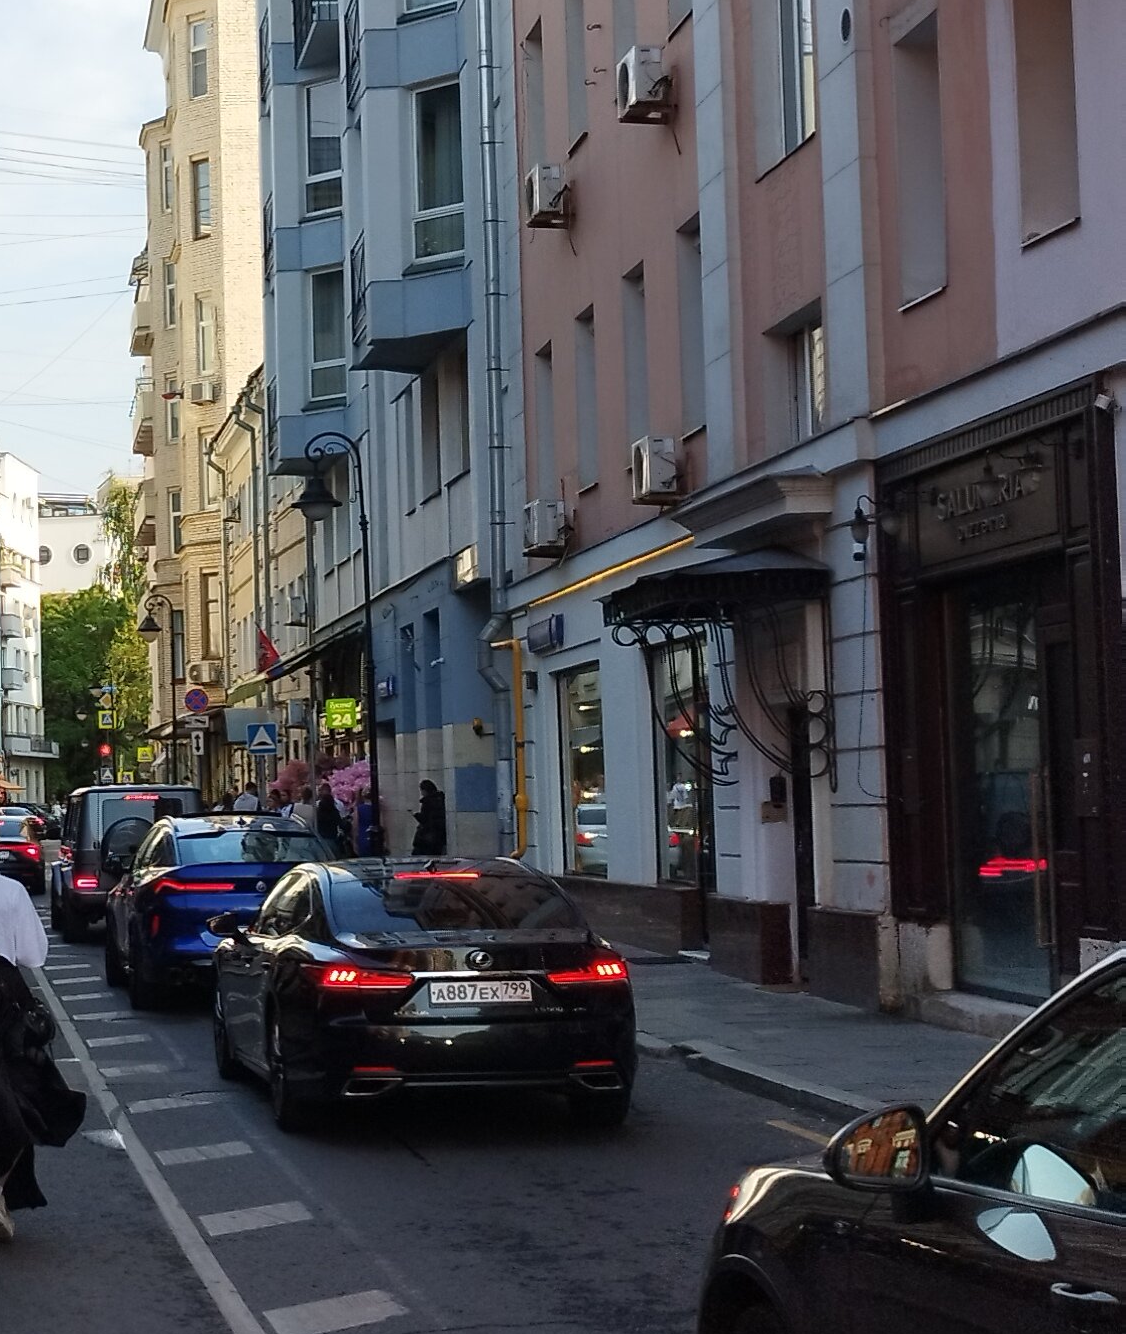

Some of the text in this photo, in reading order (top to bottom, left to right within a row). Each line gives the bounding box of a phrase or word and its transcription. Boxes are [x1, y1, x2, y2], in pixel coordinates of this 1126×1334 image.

[332, 713, 352, 726] 24
[436, 982, 526, 1001] А887ЕХ 799
